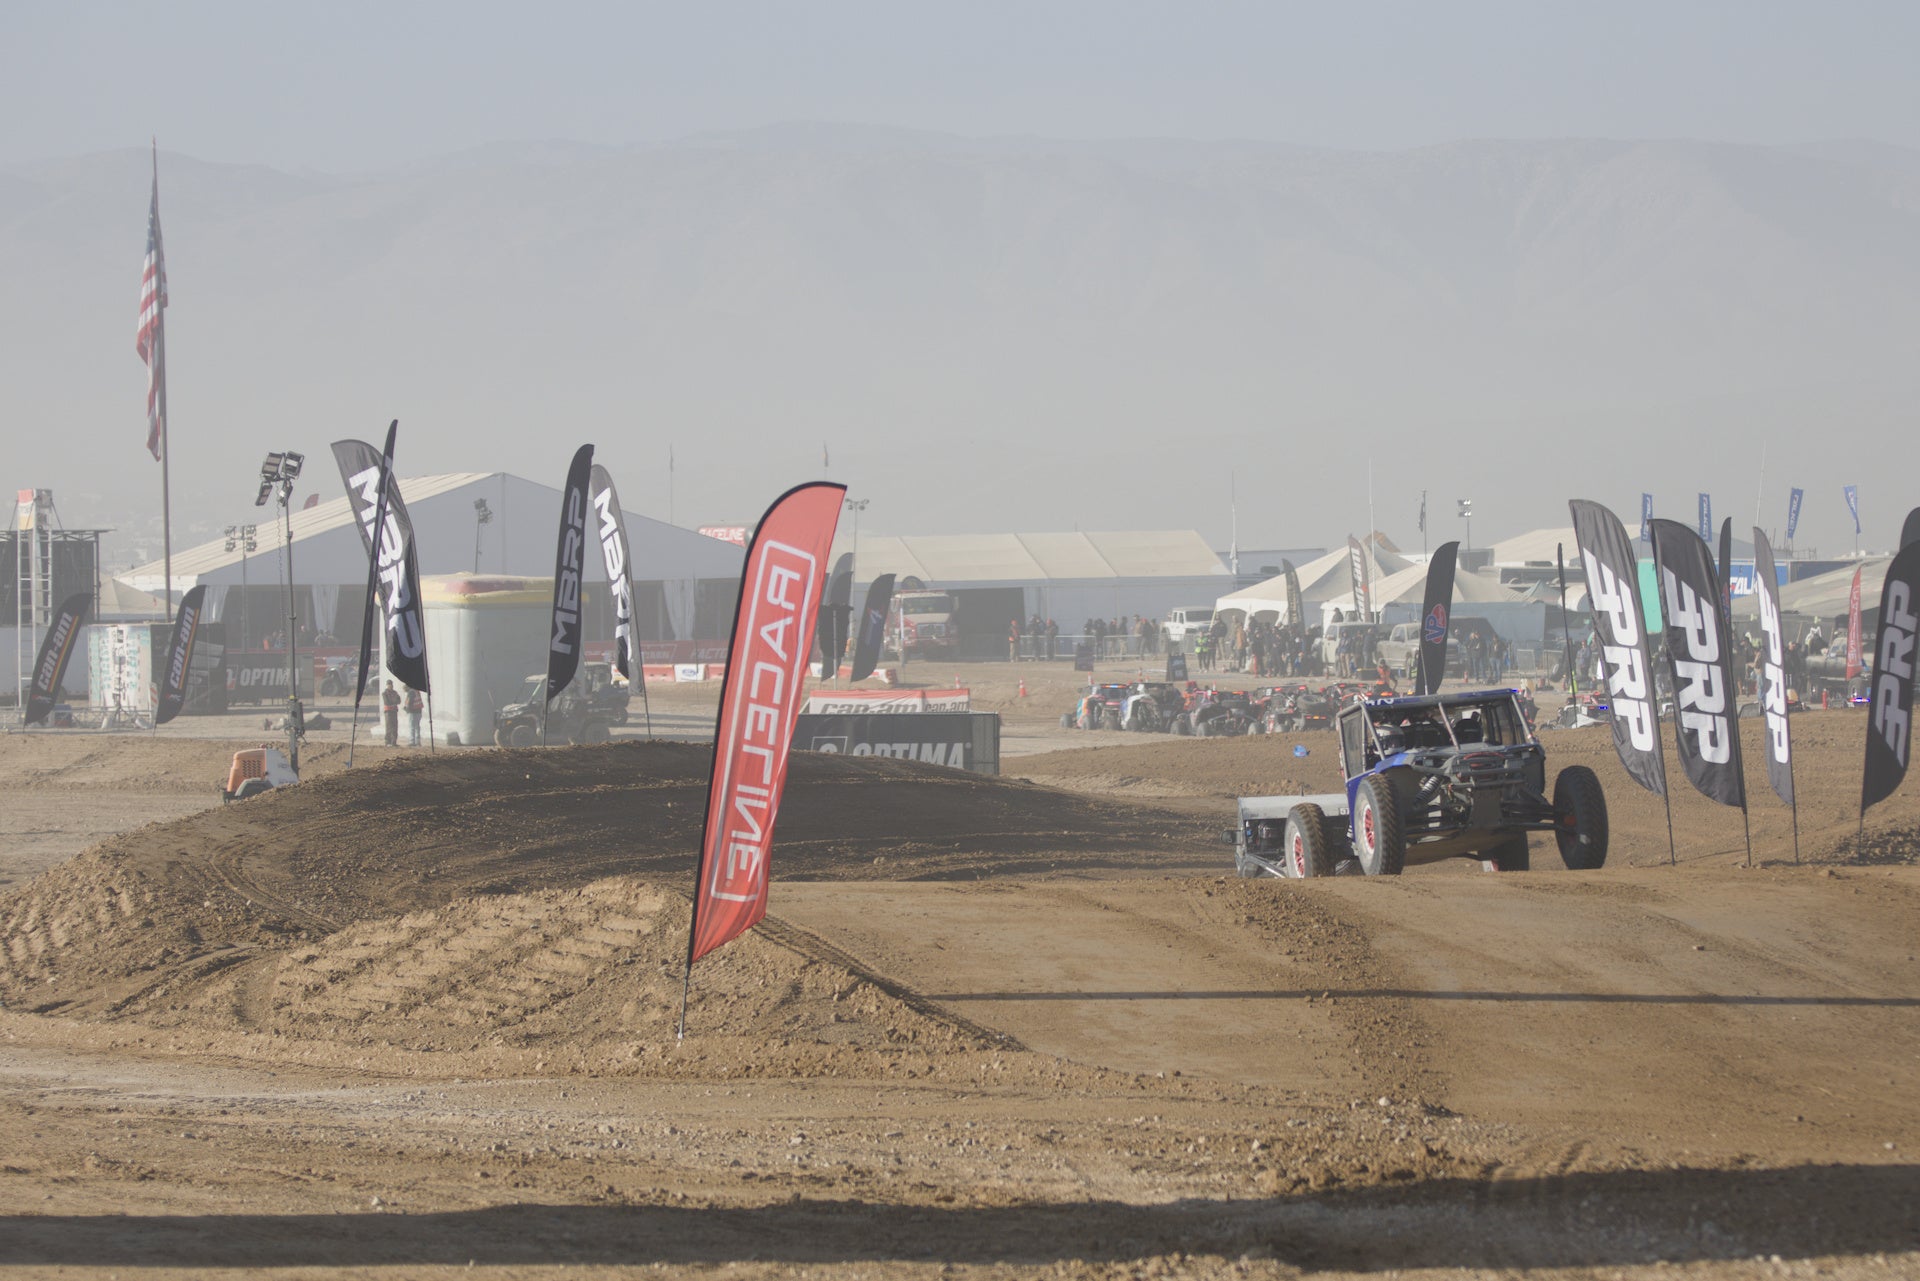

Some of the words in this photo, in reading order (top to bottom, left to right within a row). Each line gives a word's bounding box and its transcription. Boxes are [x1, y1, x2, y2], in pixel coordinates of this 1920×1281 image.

[38, 611, 74, 691] can-am
[170, 606, 195, 690] can-am
[551, 487, 584, 655] MBRP
[1425, 615, 1444, 641] VP
[1583, 548, 1654, 752] PRP
[1662, 566, 1730, 764] PRP
[1757, 571, 1789, 764] PRP
[1876, 580, 1918, 766] PRP
